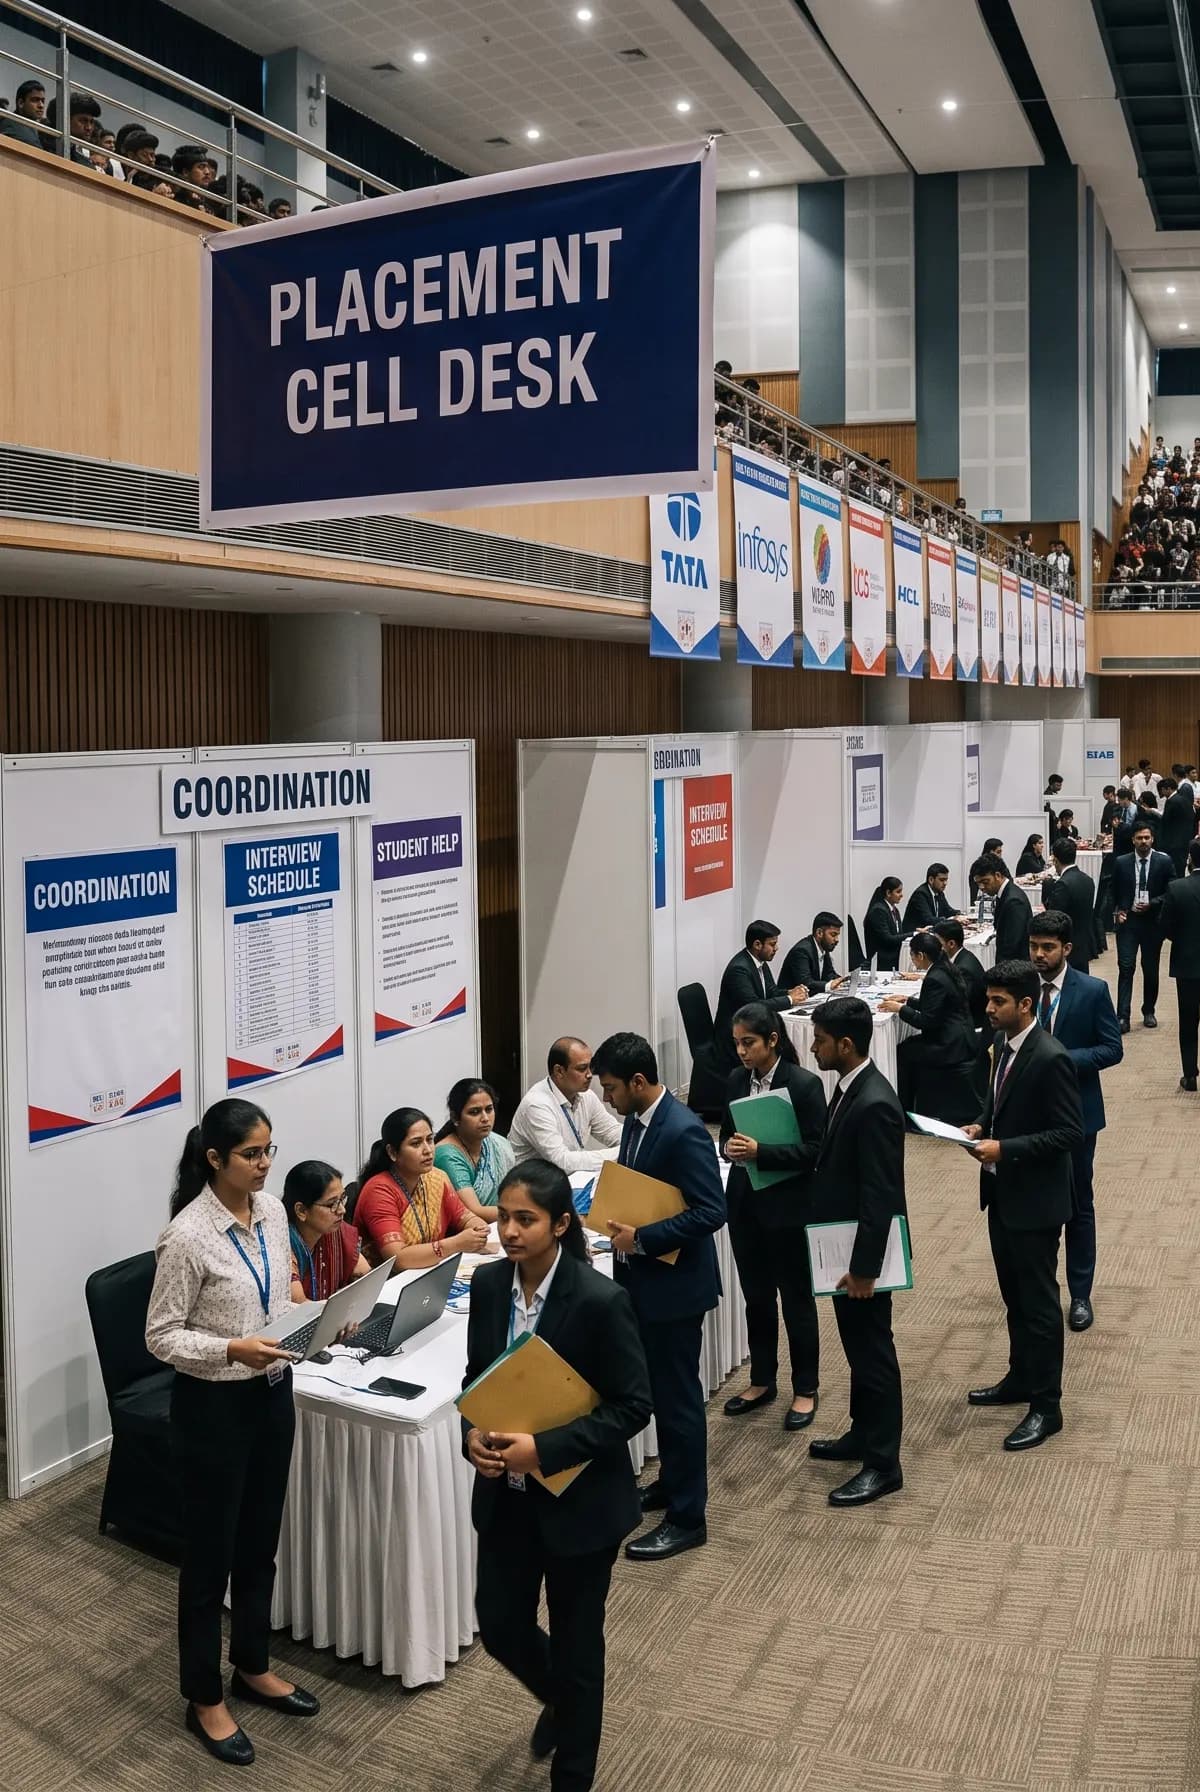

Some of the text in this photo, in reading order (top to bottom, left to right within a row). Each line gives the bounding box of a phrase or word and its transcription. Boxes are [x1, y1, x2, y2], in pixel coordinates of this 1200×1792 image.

[270, 227, 622, 347] PLACEMENT
[286, 331, 598, 434] CELL DESK
[661, 550, 708, 590] TATA
[897, 584, 920, 607] HCL
[173, 768, 371, 820] COORDINATION
[245, 840, 322, 871] INTERVIEW
[376, 832, 459, 863] STUDENT HELP
[33, 870, 171, 910] COORDINATION
[247, 866, 320, 898] SCHEDULE
